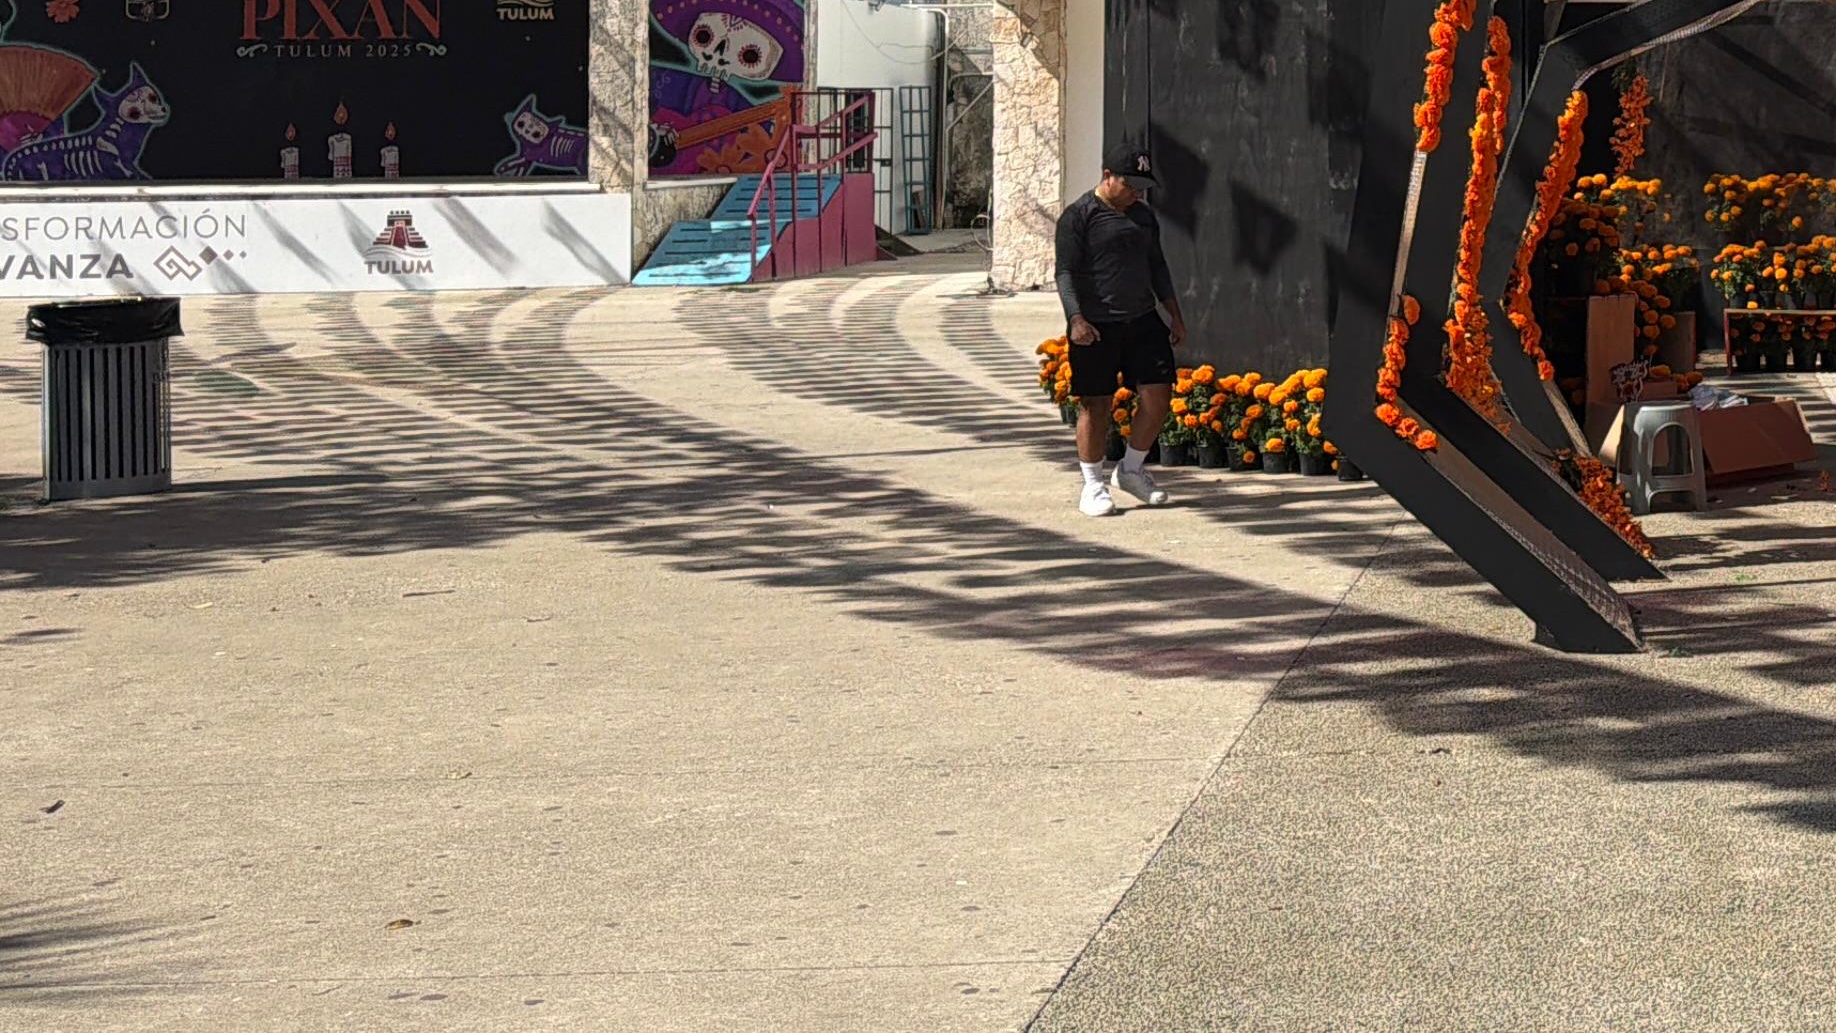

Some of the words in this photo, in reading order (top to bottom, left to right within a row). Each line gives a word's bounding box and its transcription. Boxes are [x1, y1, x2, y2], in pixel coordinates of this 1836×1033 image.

[495, 7, 555, 21] TULUM
[273, 44, 351, 58] TULUM
[365, 44, 411, 58] 2025
[1, 209, 247, 242] SFORMACIÓN
[364, 259, 434, 275] TULUM
